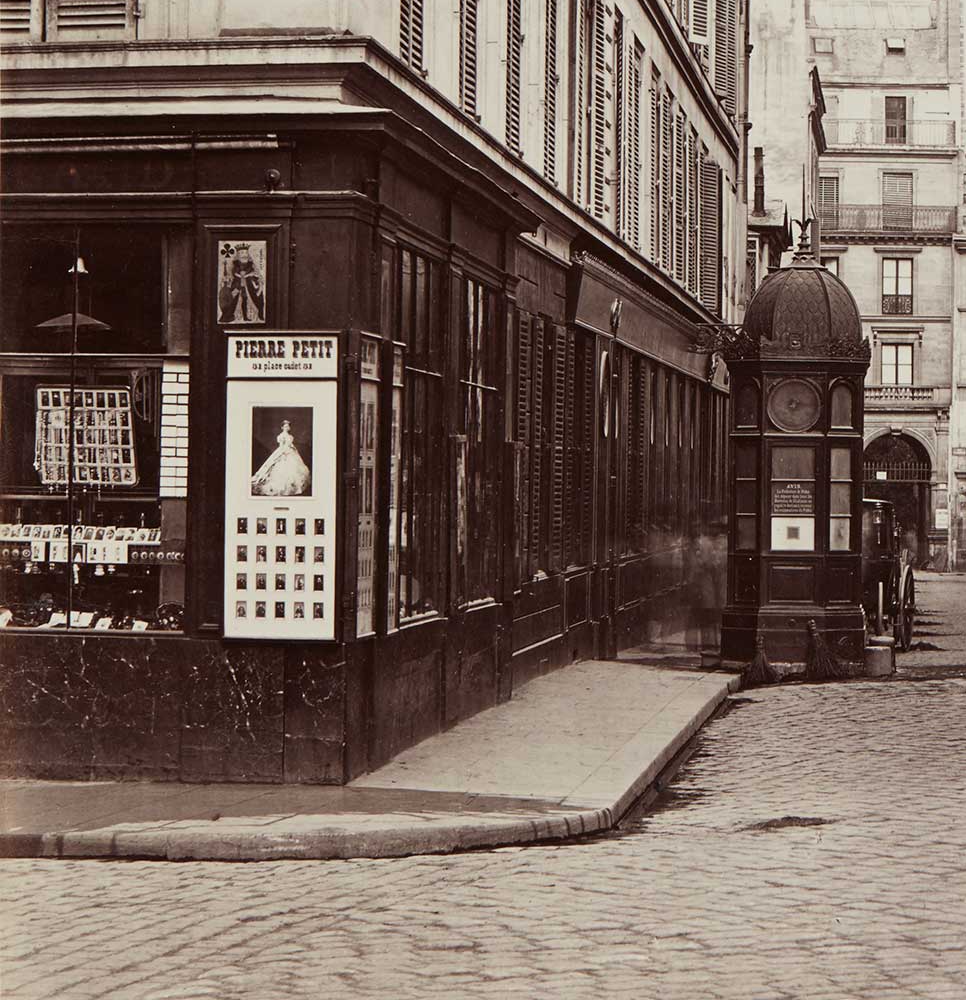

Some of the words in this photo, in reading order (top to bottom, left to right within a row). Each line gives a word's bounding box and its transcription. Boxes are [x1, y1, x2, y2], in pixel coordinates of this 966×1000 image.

[235, 340, 286, 359] PIERRE
[292, 340, 333, 359] PETIT
[264, 360, 283, 372] place
